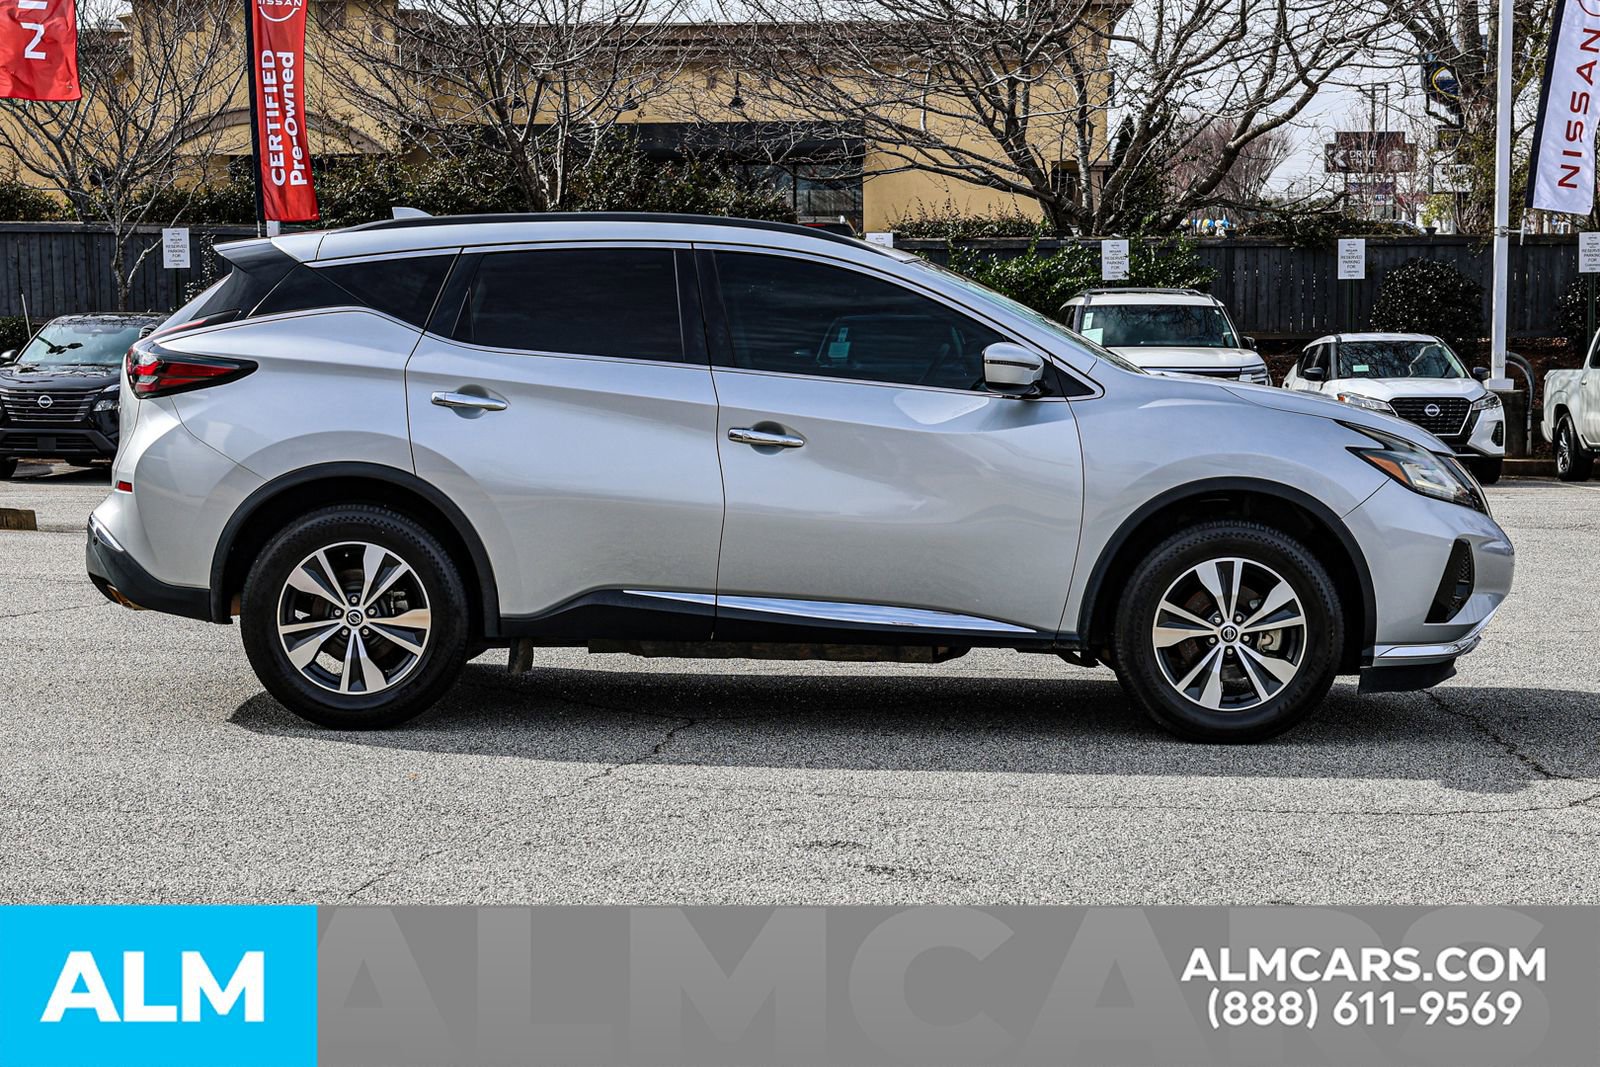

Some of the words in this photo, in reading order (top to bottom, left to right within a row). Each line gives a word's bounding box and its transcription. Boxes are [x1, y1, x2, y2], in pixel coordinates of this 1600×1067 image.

[261, 49, 286, 186] CERTIFIED
[276, 51, 308, 186] Pre-Owned
[1557, 27, 1600, 189] NISSAN
